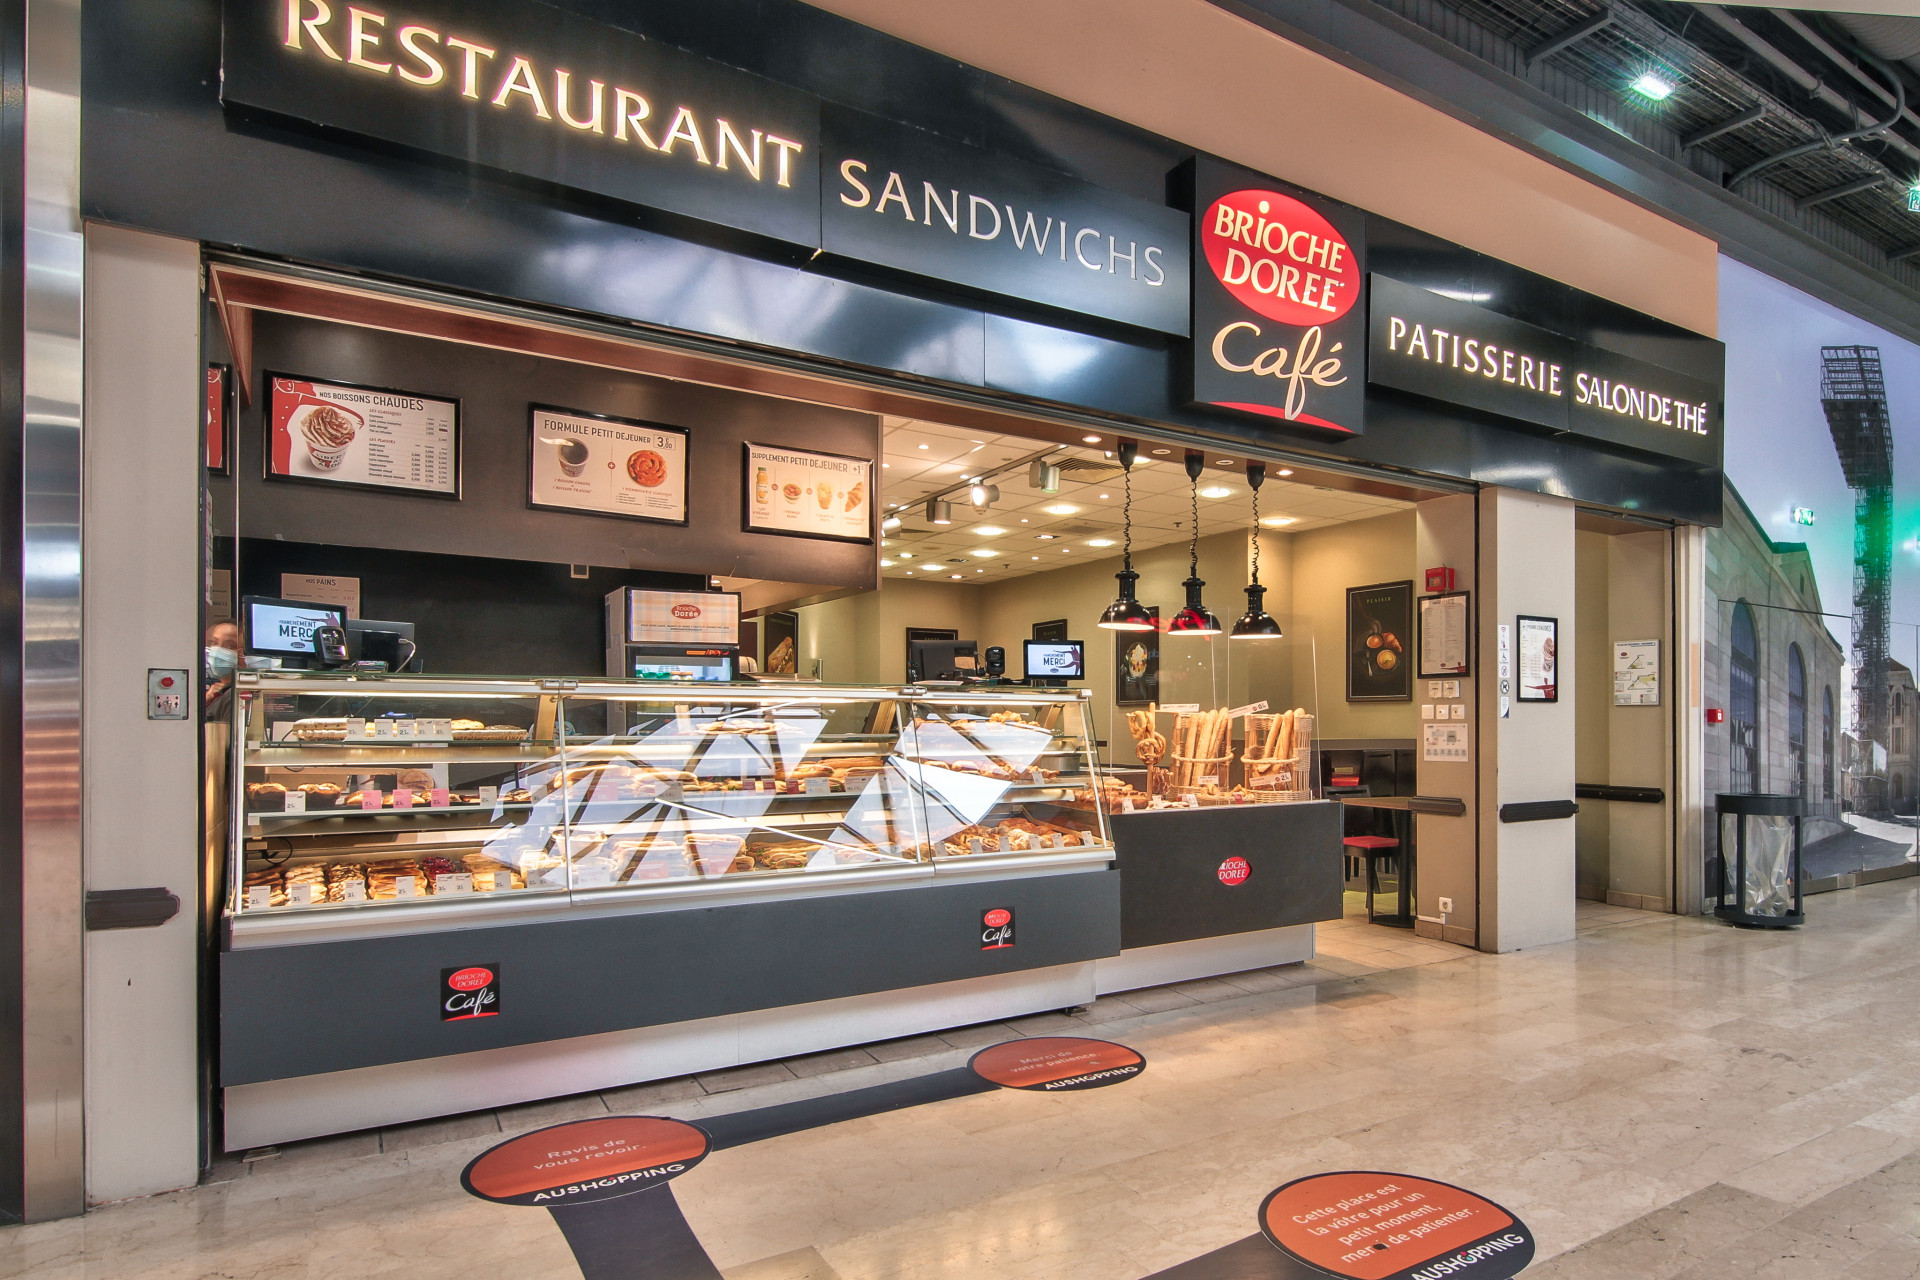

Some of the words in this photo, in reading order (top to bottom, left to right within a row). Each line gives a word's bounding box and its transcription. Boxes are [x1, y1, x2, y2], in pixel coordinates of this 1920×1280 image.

[284, 0, 803, 188] RESTAURANT
[840, 159, 1166, 286] SANDWICHS
[1214, 200, 1346, 274] BRIOCHE
[1388, 317, 1562, 397] PATISSERIE
[1212, 321, 1348, 421] Café
[319, 391, 332, 399] NOS
[332, 392, 371, 404] BOISSONS
[373, 396, 424, 411] CHAUDES
[1576, 373, 1645, 420] SALON
[1648, 393, 1673, 427] DE
[1674, 401, 1708, 436] THÉ
[544, 419, 589, 435] FORMULE
[591, 427, 614, 439] PETIT
[790, 456, 808, 467] PETIT
[316, 578, 337, 586] PAINS
[279, 619, 316, 628] FRANCHEMENT
[279, 624, 316, 638] MERC
[1043, 657, 1065, 666] MERCI
[982, 924, 1012, 947] Café
[445, 987, 496, 1016] Café
[1010, 1061, 1045, 1073] votre
[1019, 1053, 1056, 1065] Merci
[1057, 1050, 1073, 1058] de
[1045, 1066, 1139, 1090] AUSHOPPING
[547, 1142, 600, 1159] Ravis
[603, 1138, 626, 1149] de
[533, 1157, 582, 1170] vous
[532, 1163, 686, 1202] AUSHOPPING
[1292, 1203, 1338, 1224] Cette
[1340, 1189, 1377, 1213] place
[1378, 1183, 1402, 1196] est
[1307, 1227, 1330, 1237] la
[1328, 1208, 1371, 1231] vôtre
[1368, 1198, 1404, 1217] pour
[1403, 1190, 1426, 1203] un
[1338, 1225, 1378, 1246] petit
[1377, 1202, 1443, 1230] moment,
[1389, 1230, 1412, 1246] de
[1408, 1207, 1480, 1239] patienter.
[1411, 1233, 1525, 1280] AUSHOPPING
